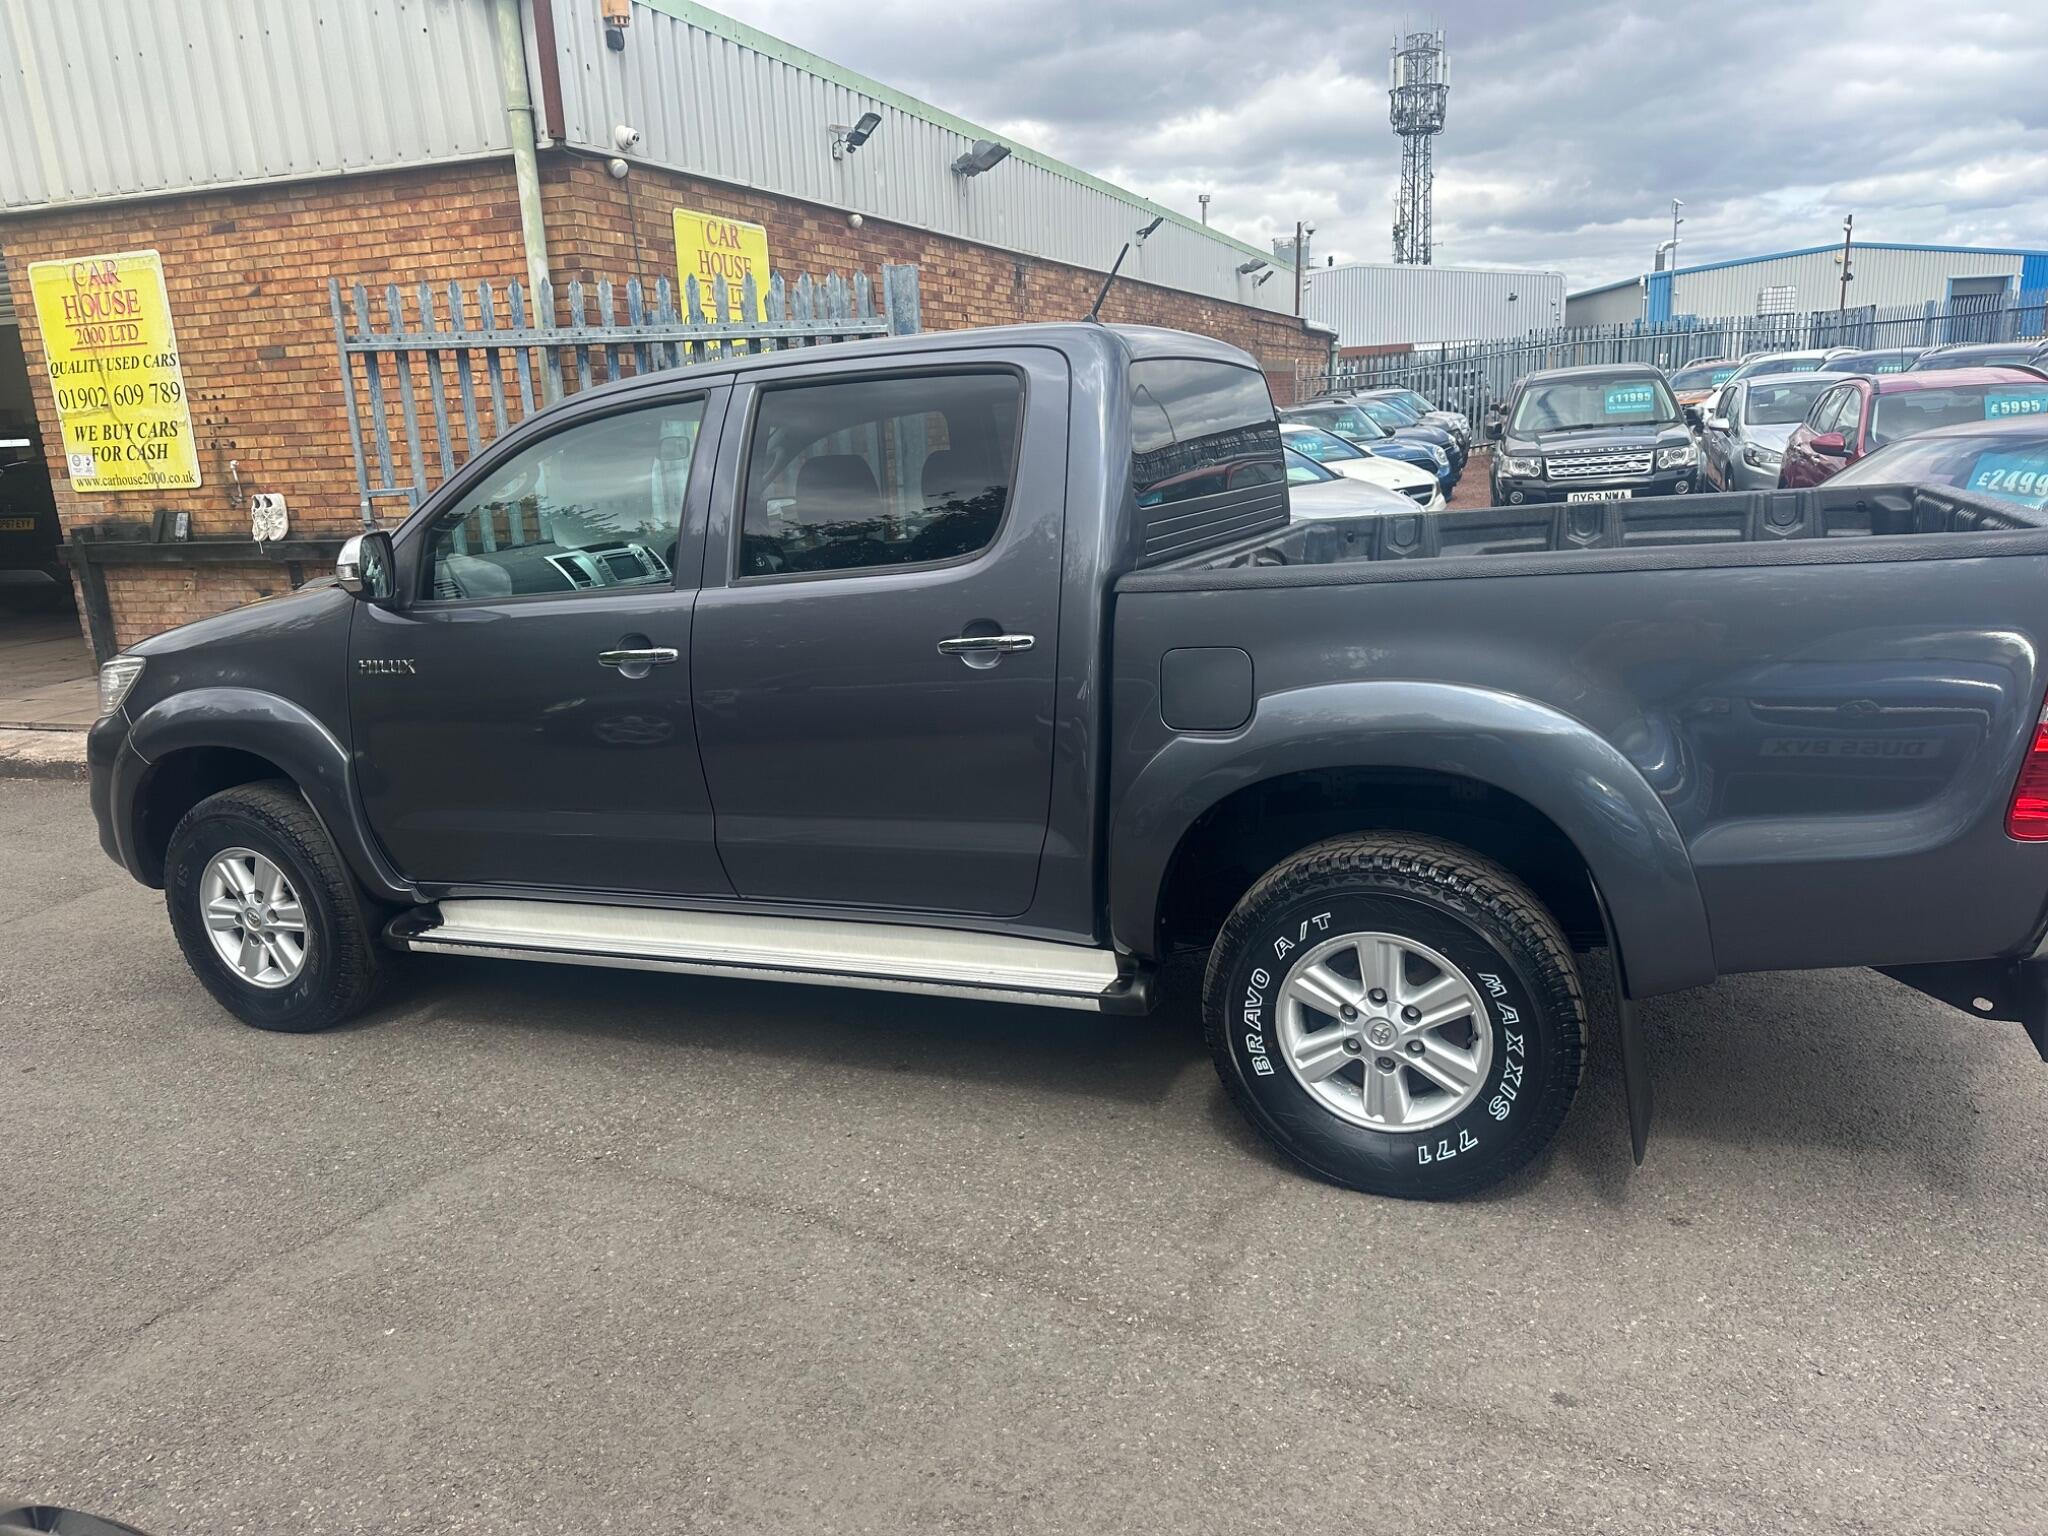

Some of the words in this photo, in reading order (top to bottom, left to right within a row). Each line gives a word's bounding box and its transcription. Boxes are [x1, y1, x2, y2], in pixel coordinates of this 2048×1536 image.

[706, 219, 741, 249] CAR
[70, 259, 121, 287] CAR
[698, 249, 752, 280] HOUSE
[61, 288, 141, 320] HOUSE
[76, 326, 107, 345] 2000
[110, 323, 139, 341] LTD
[50, 358, 104, 378] QUALITY
[106, 356, 139, 372] USED
[143, 353, 177, 369] CARS
[58, 387, 109, 410] 01902
[114, 384, 144, 406] 609
[149, 381, 181, 404] 789
[1990, 400, 2041, 415] £5995
[75, 425, 98, 442] WE
[103, 423, 133, 441] BUY
[137, 420, 178, 439] CARS
[91, 446, 122, 462] FOR
[126, 443, 169, 461] CASH
[77, 470, 195, 487] www.carhouse2000.co.uk
[358, 658, 416, 674] HILUX
[1243, 968, 1275, 1077] BRAVO
[1273, 911, 1332, 960] A/T
[1477, 973, 1525, 1122] MAXXIS
[1418, 1129, 1479, 1165] 771
